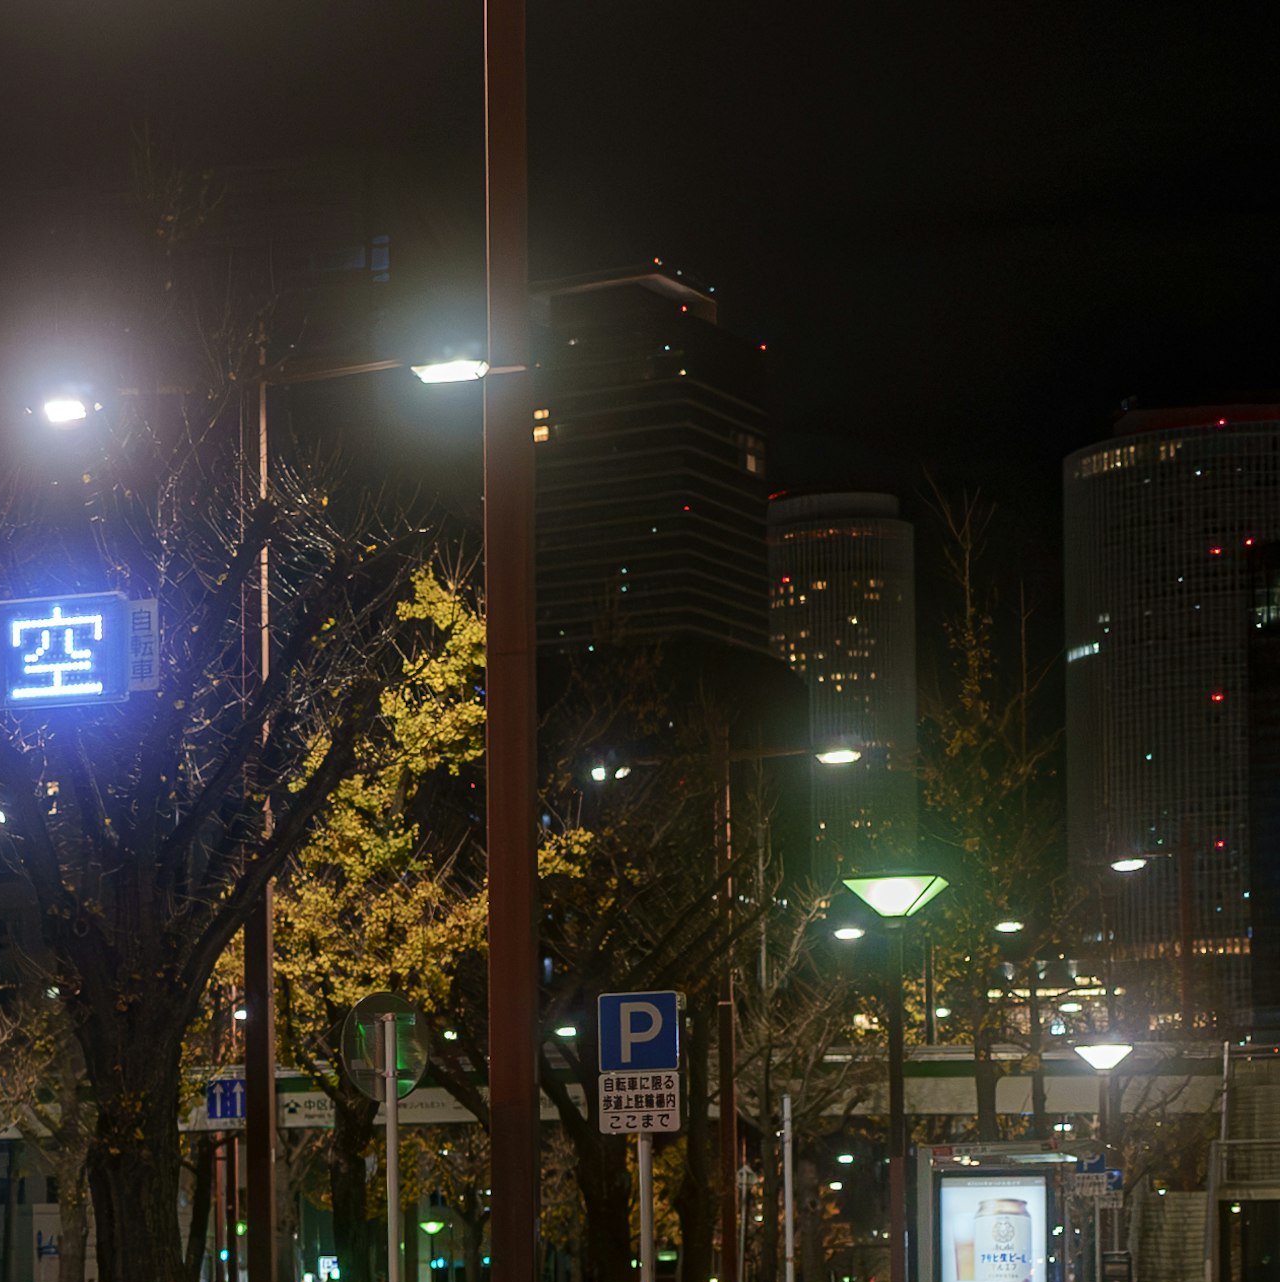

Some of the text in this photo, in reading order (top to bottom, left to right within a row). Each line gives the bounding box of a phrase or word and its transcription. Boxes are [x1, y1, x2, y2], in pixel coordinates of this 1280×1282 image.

[12, 606, 103, 699] 空
[131, 608, 154, 682] 自転車
[620, 1002, 663, 1063] P
[603, 1093, 676, 1110] 歩道上駐輪場内
[604, 1075, 674, 1092] 自転車に限る
[610, 1114, 670, 1129] ここまで
